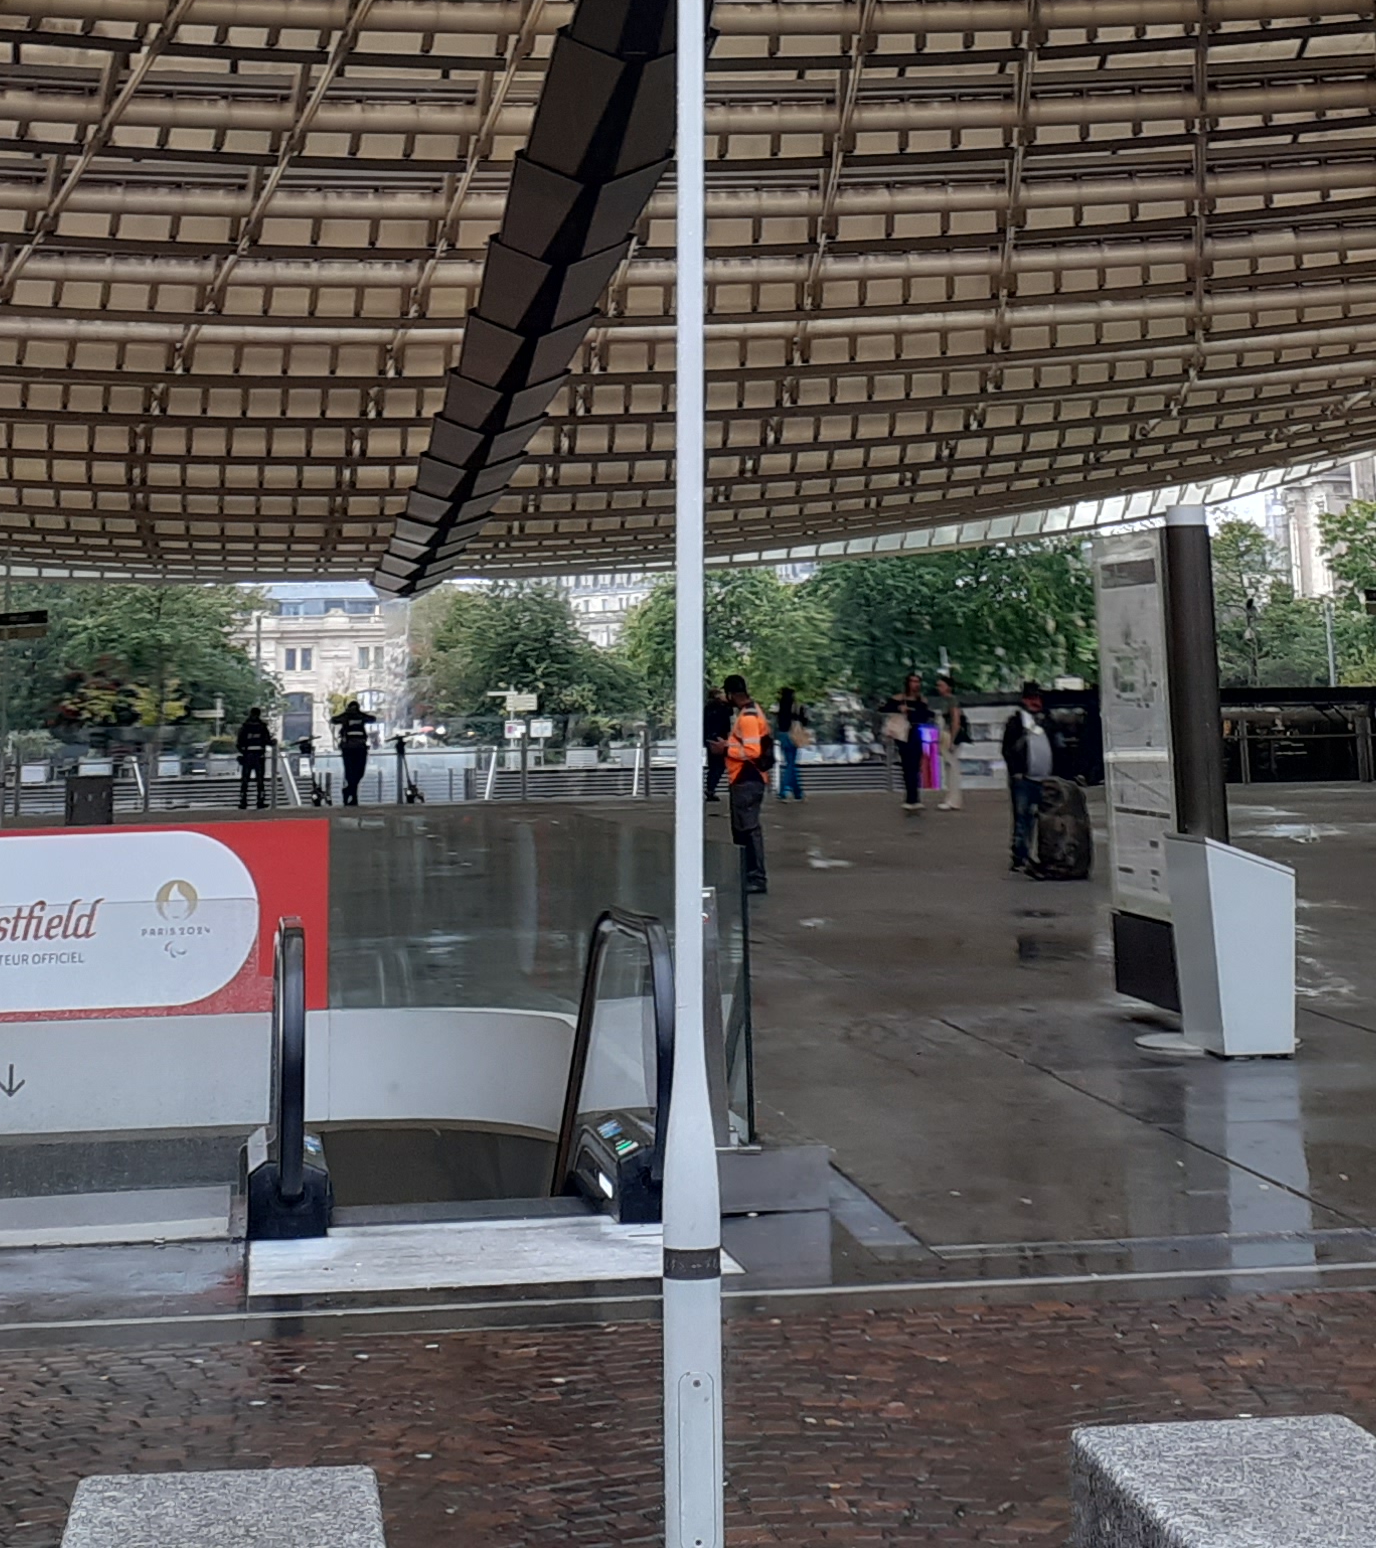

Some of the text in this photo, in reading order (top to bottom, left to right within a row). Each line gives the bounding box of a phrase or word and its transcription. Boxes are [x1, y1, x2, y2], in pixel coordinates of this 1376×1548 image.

[141, 926, 211, 937] PARIS 2024
[31, 952, 85, 965] OFFICIEL
